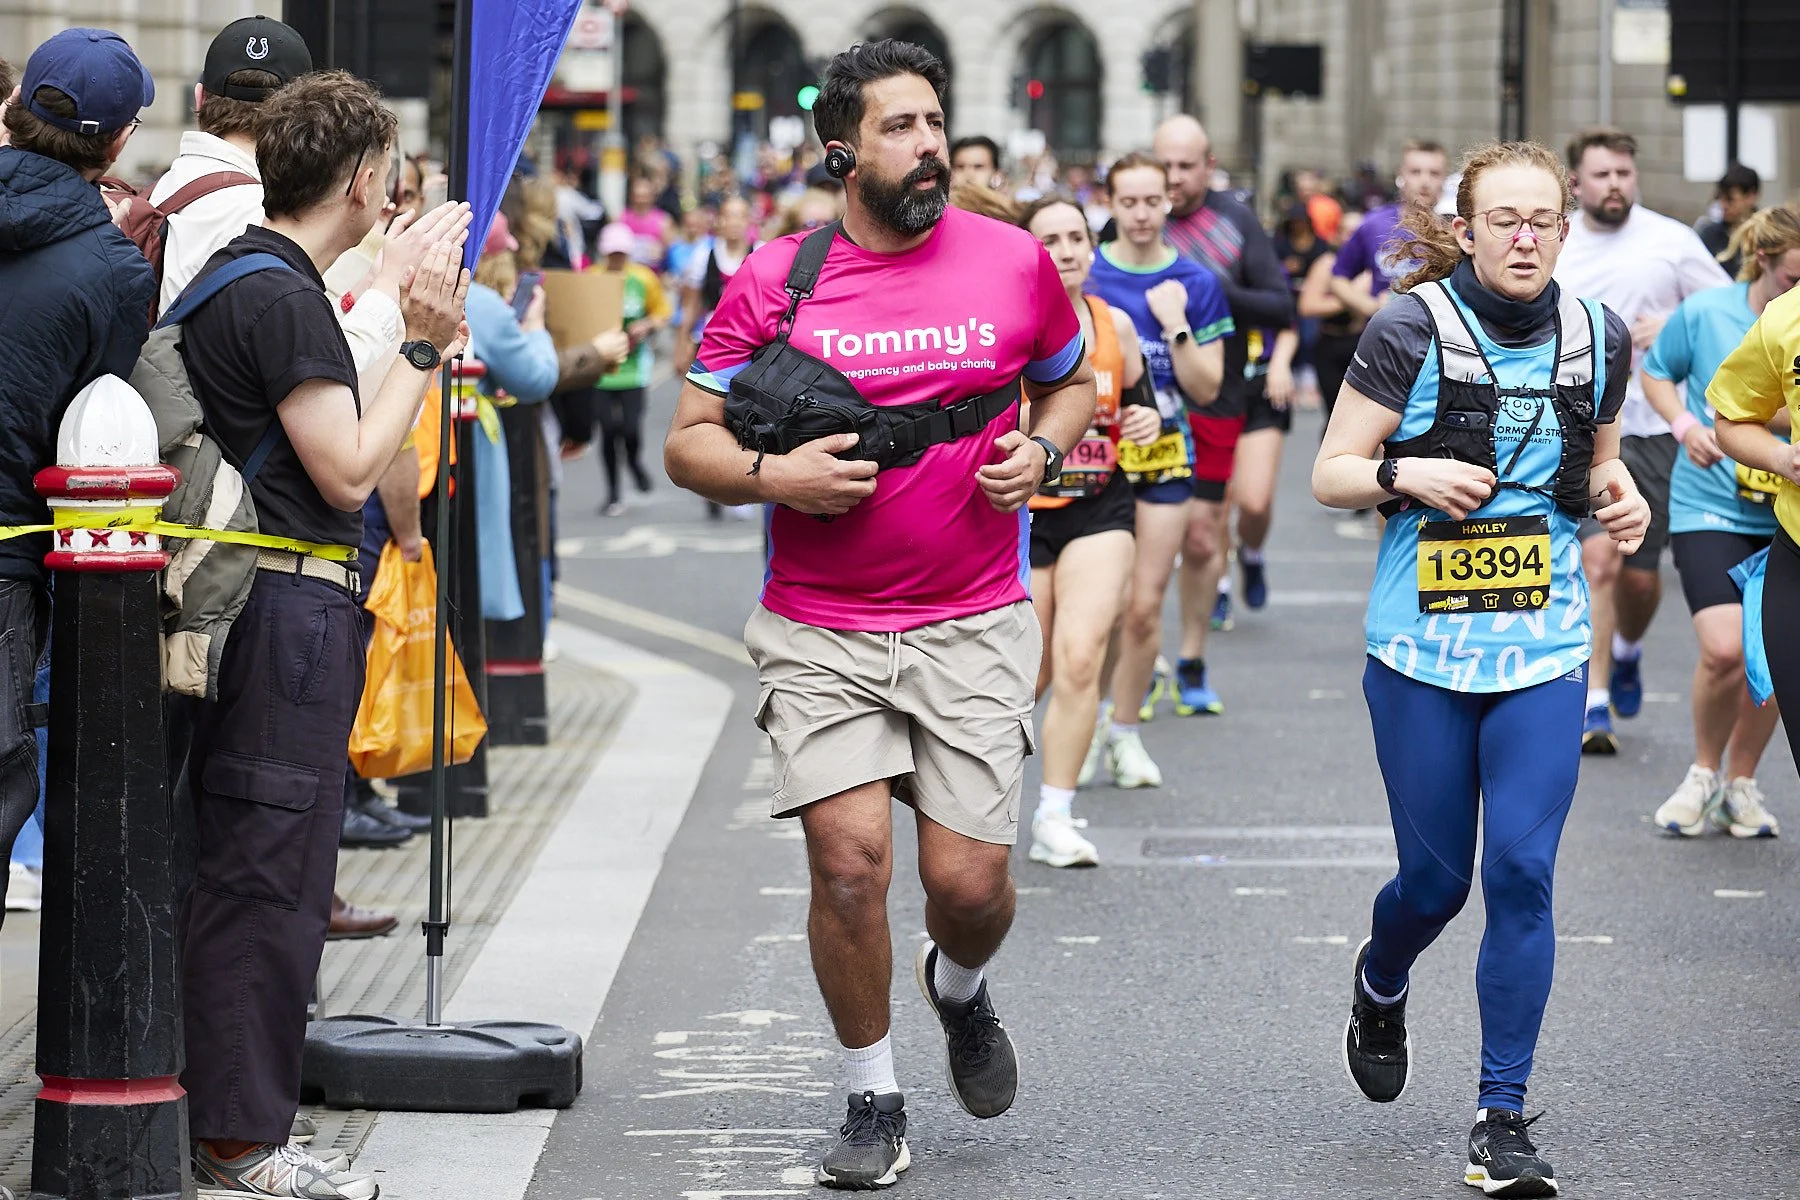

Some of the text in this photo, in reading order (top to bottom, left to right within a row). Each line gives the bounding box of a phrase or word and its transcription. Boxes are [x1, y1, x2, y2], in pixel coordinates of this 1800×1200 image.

[813, 317, 997, 359] Tommy's
[903, 361, 925, 373] and
[928, 359, 958, 371] baby
[960, 357, 997, 370] charity
[1496, 425, 1543, 436] ORMOD
[1462, 522, 1508, 535] HAYLEY
[1428, 544, 1544, 581] 13394
